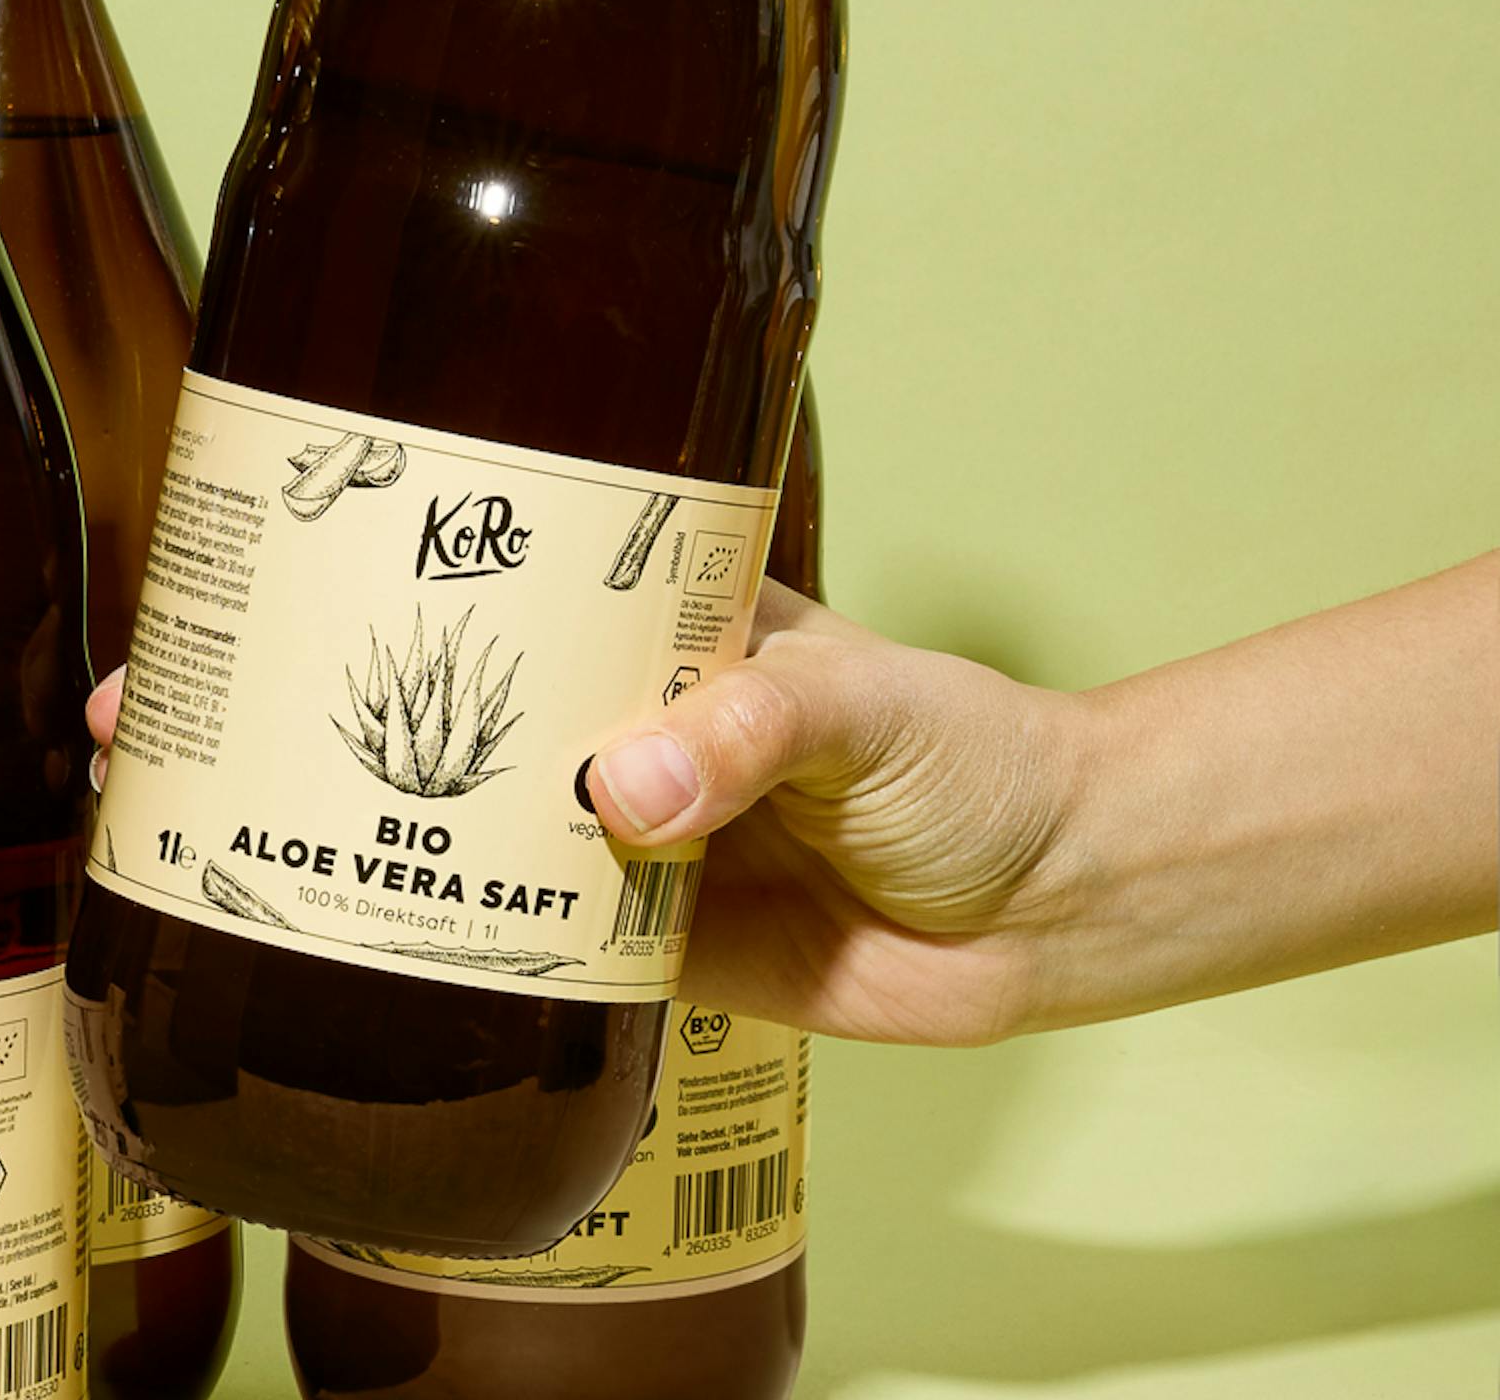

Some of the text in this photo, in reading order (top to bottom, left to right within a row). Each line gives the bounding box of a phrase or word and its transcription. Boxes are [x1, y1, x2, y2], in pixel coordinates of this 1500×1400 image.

[416, 491, 533, 580] KoRo
[666, 531, 686, 585] Symbolbild
[375, 816, 452, 856] BIO
[568, 821, 613, 840] vega
[229, 825, 580, 921] ALOE VERA SAFT
[355, 899, 457, 935] Direktsaft
[599, 939, 609, 954] 4
[98, 1212, 106, 1224] 4
[120, 1202, 165, 1222] 260335
[662, 1220, 779, 1257] 4 260335 832530
